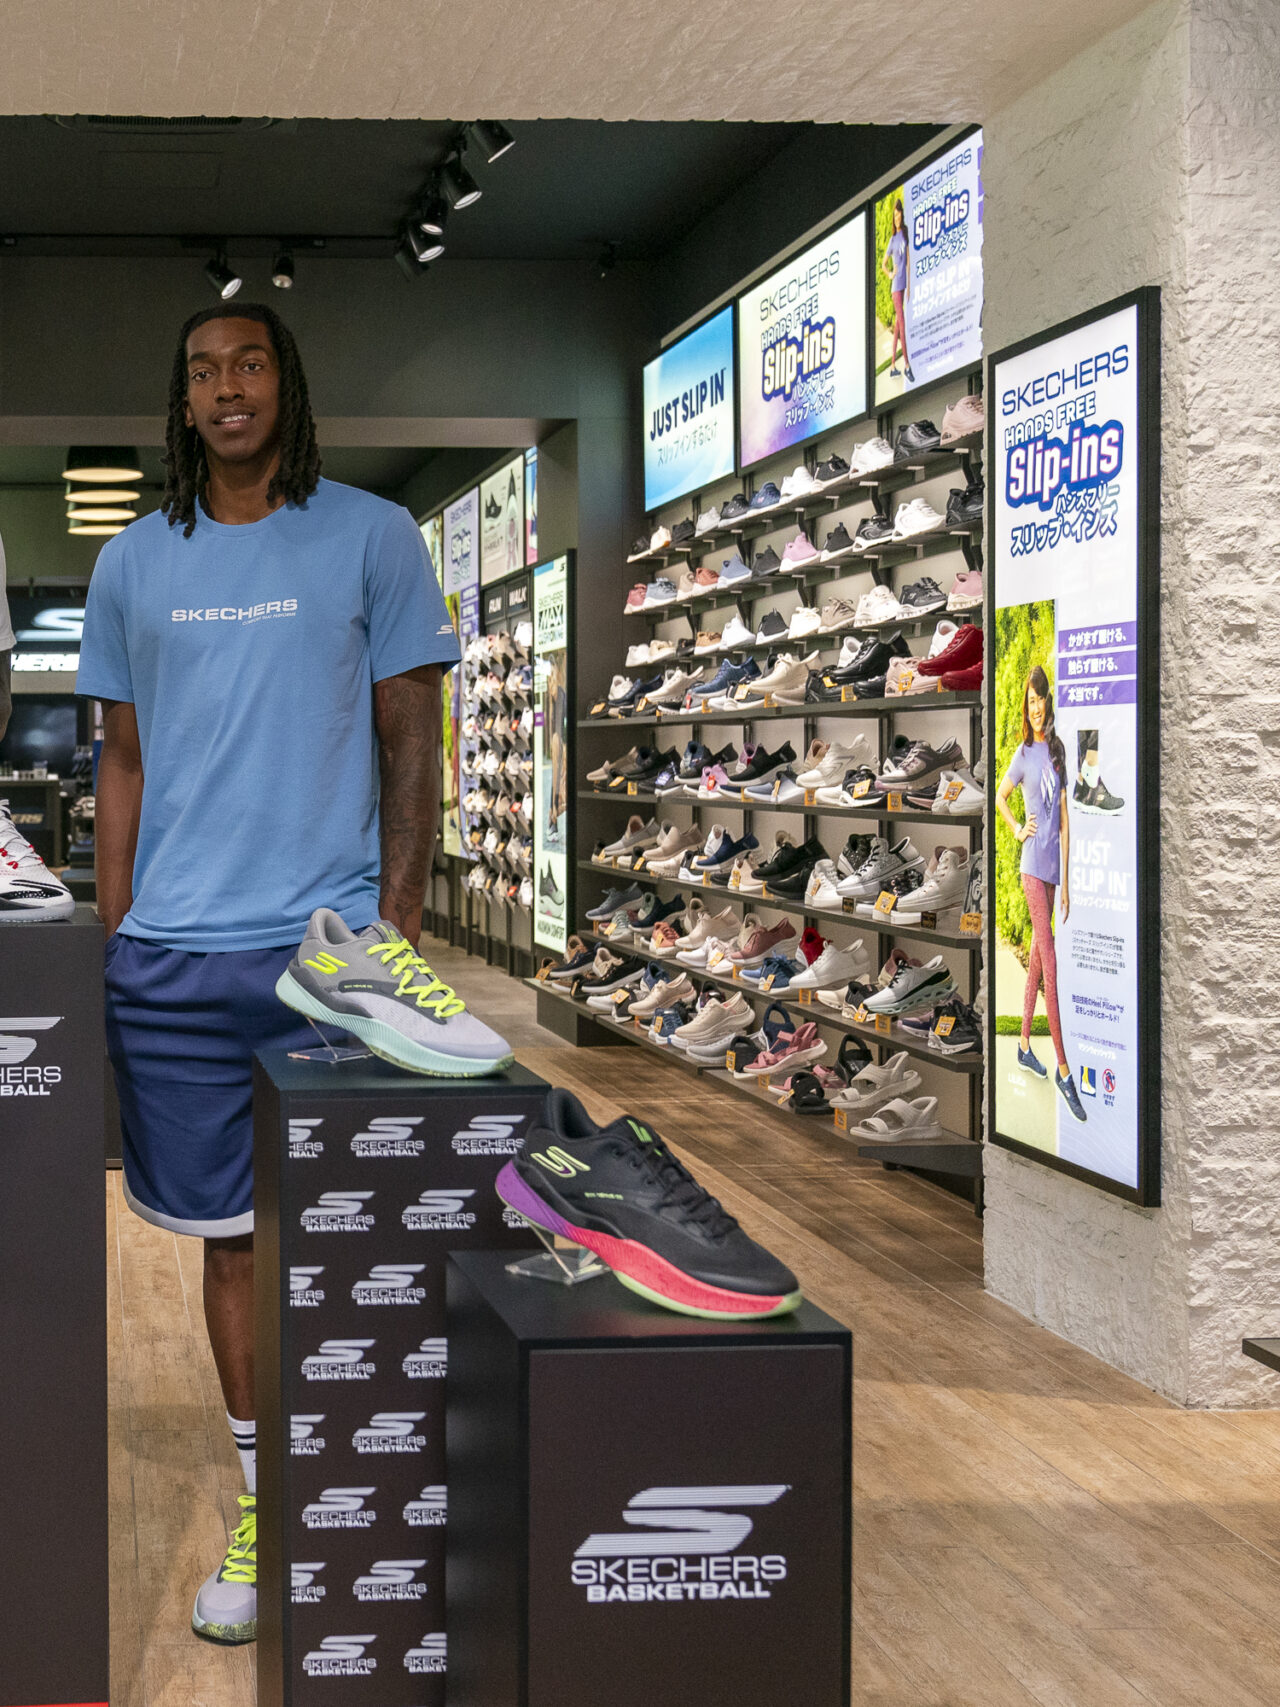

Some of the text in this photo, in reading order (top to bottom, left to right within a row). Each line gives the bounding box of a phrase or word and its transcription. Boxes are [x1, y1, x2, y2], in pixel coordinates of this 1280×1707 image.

[911, 149, 972, 200] SKECHERS
[913, 177, 958, 218] HANDS FREE
[914, 191, 969, 248] Slip-ins
[760, 251, 840, 321] SKECHERS
[936, 265, 956, 291] SLIP
[761, 293, 819, 351] HANDS FREE
[763, 320, 835, 397] Slip-ins
[1002, 344, 1129, 416] SKECHERS
[650, 368, 725, 441] JUST SLIP IN
[1005, 391, 1096, 450] HANDS FREE
[1008, 424, 1123, 504] Slip-ins
[1056, 482, 1120, 515] ハンズフリー
[1011, 499, 1118, 558] スリップ・インズ
[509, 585, 527, 607] WALK
[171, 598, 298, 622] SKECHERS
[1068, 686, 1103, 702] 本当です。
[1072, 839, 1111, 866] JUST
[1072, 866, 1127, 897] SLIP IN
[351, 1141, 424, 1150] SKECHERS
[451, 1138, 525, 1149] SKECHERS
[300, 1215, 374, 1225] SKECHERS
[402, 1213, 476, 1223] SKECHERS
[407, 1222, 470, 1230] BASKETBALL
[306, 1224, 369, 1232] BASKETBALL
[352, 1288, 426, 1298] SKECHERS
[357, 1297, 420, 1305] BASKETBALL
[301, 1363, 376, 1374] SKECHERS
[307, 1372, 370, 1380] BASKETBALL
[352, 1436, 426, 1446] SKECHERS
[357, 1445, 421, 1453] BASKETBALL
[302, 1511, 376, 1521] SKECHERS
[307, 1520, 371, 1528] BASKETBALL
[571, 1554, 787, 1585] SKECHERS
[353, 1584, 426, 1594] SKECHERS
[358, 1593, 421, 1601] BASKETBALL
[586, 1580, 771, 1603] BASKETBALL
[303, 1658, 376, 1669] SKECHERS
[308, 1668, 371, 1676] BASKETBALL
